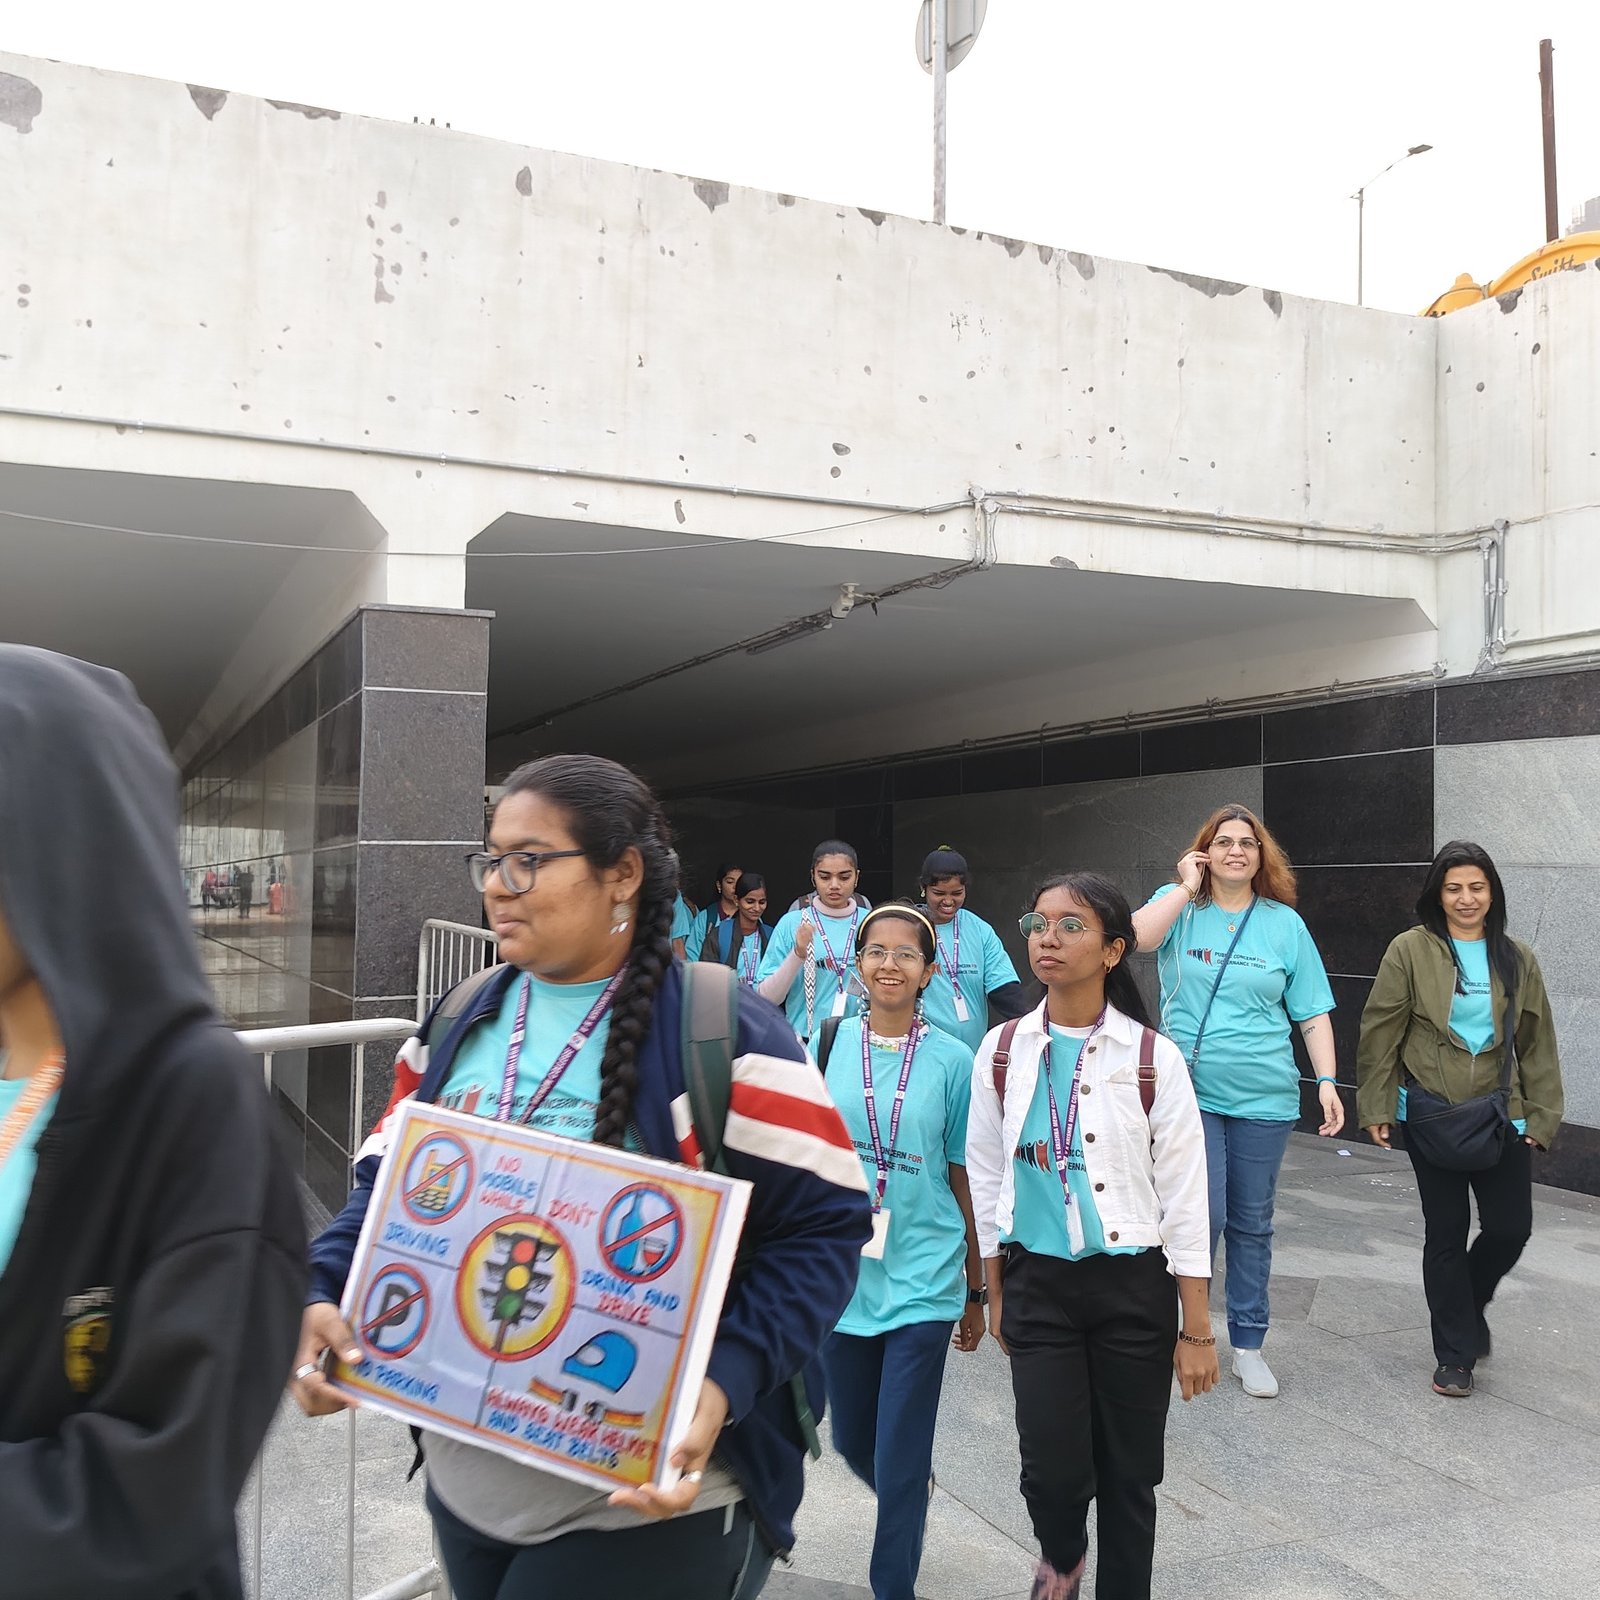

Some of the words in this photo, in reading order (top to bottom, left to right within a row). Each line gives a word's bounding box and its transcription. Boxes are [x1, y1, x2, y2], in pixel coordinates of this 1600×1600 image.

[495, 1154, 522, 1173] NO
[897, 1163, 921, 1176] TRUST
[907, 1153, 923, 1164] FOR
[478, 1171, 538, 1199] MOBILE
[385, 1221, 450, 1259] DRIVING
[597, 1292, 652, 1326] DRIVE
[643, 1288, 680, 1312] AND
[487, 1409, 520, 1434] AND
